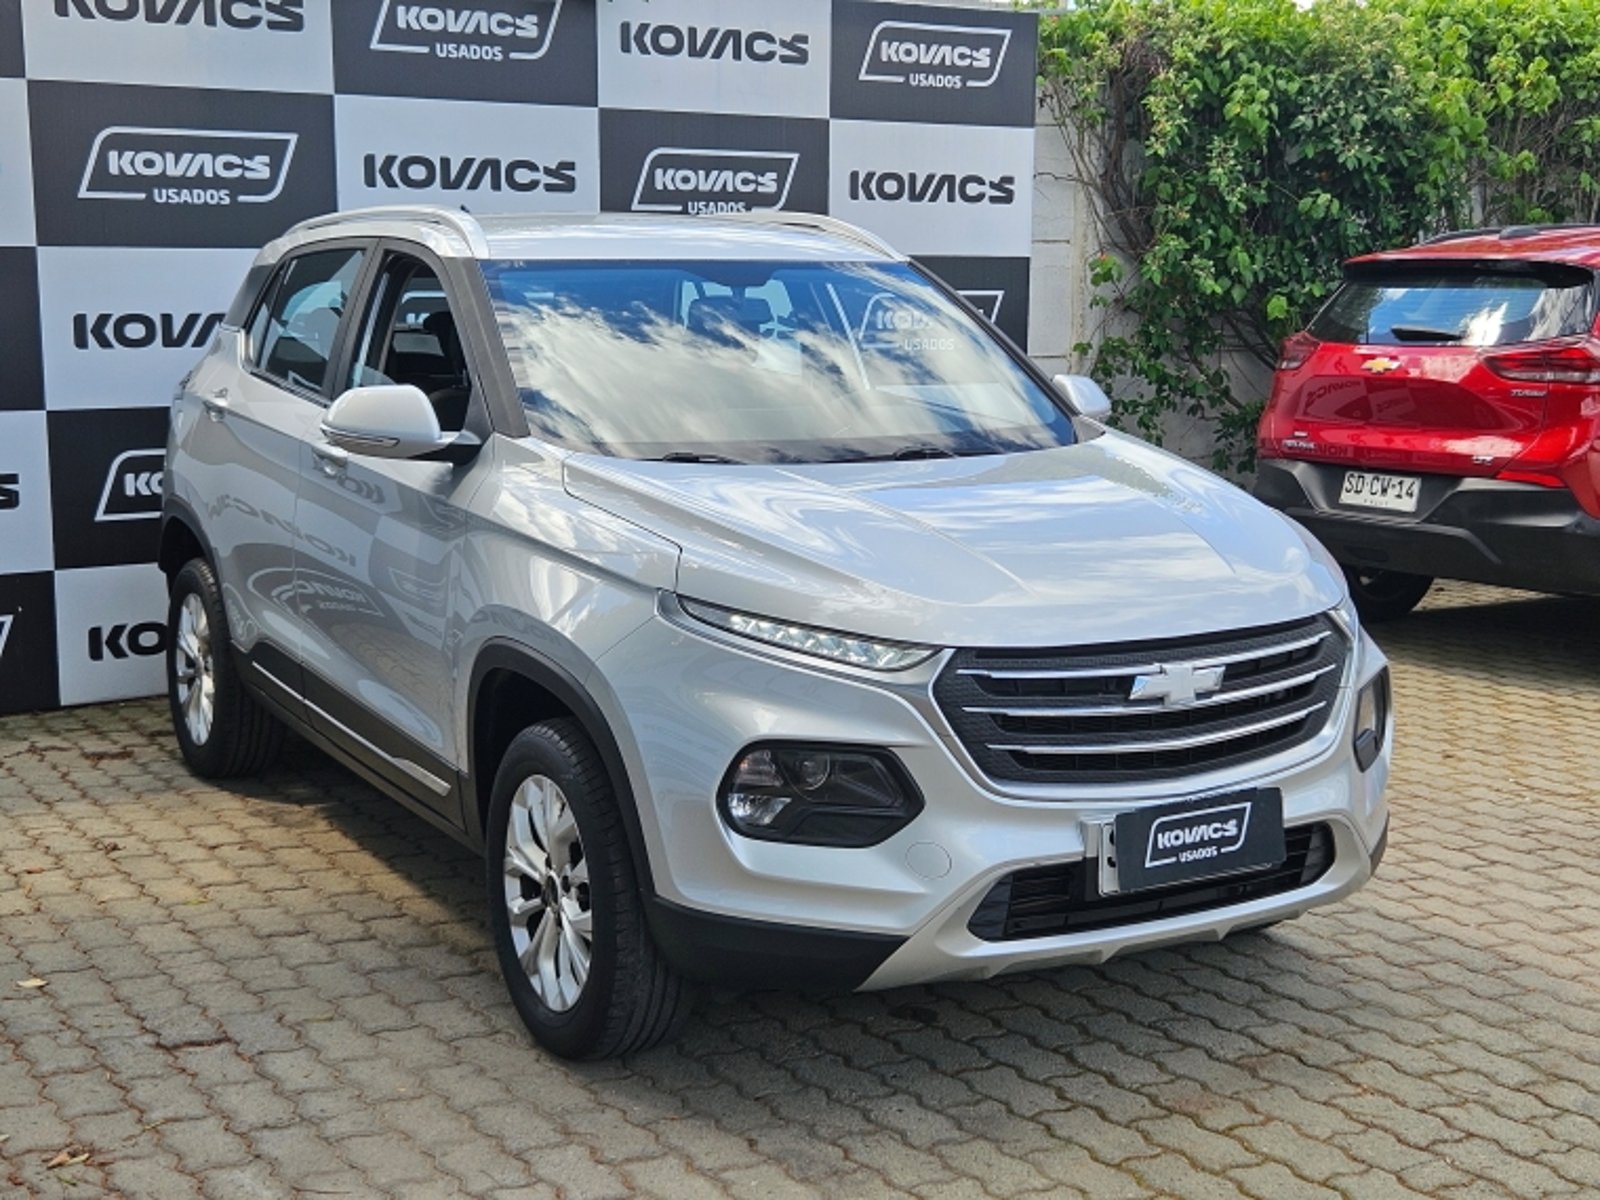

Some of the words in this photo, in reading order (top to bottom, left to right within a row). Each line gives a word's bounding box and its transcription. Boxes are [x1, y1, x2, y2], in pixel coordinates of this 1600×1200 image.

[396, 5, 539, 39] KOVACS
[435, 42, 504, 61] USADOS
[620, 21, 810, 65] KOVACS
[880, 40, 992, 68] KOVACS
[909, 73, 962, 89] USADOS
[107, 149, 271, 180] KOVACS
[363, 153, 576, 193] KOVACS
[654, 168, 778, 193] KOVACS
[849, 170, 1015, 205] KOVACS
[152, 187, 231, 205] USADOS
[687, 201, 746, 216] USADOS
[1157, 819, 1239, 849] KOVACS
[1178, 846, 1218, 862] USADOS
